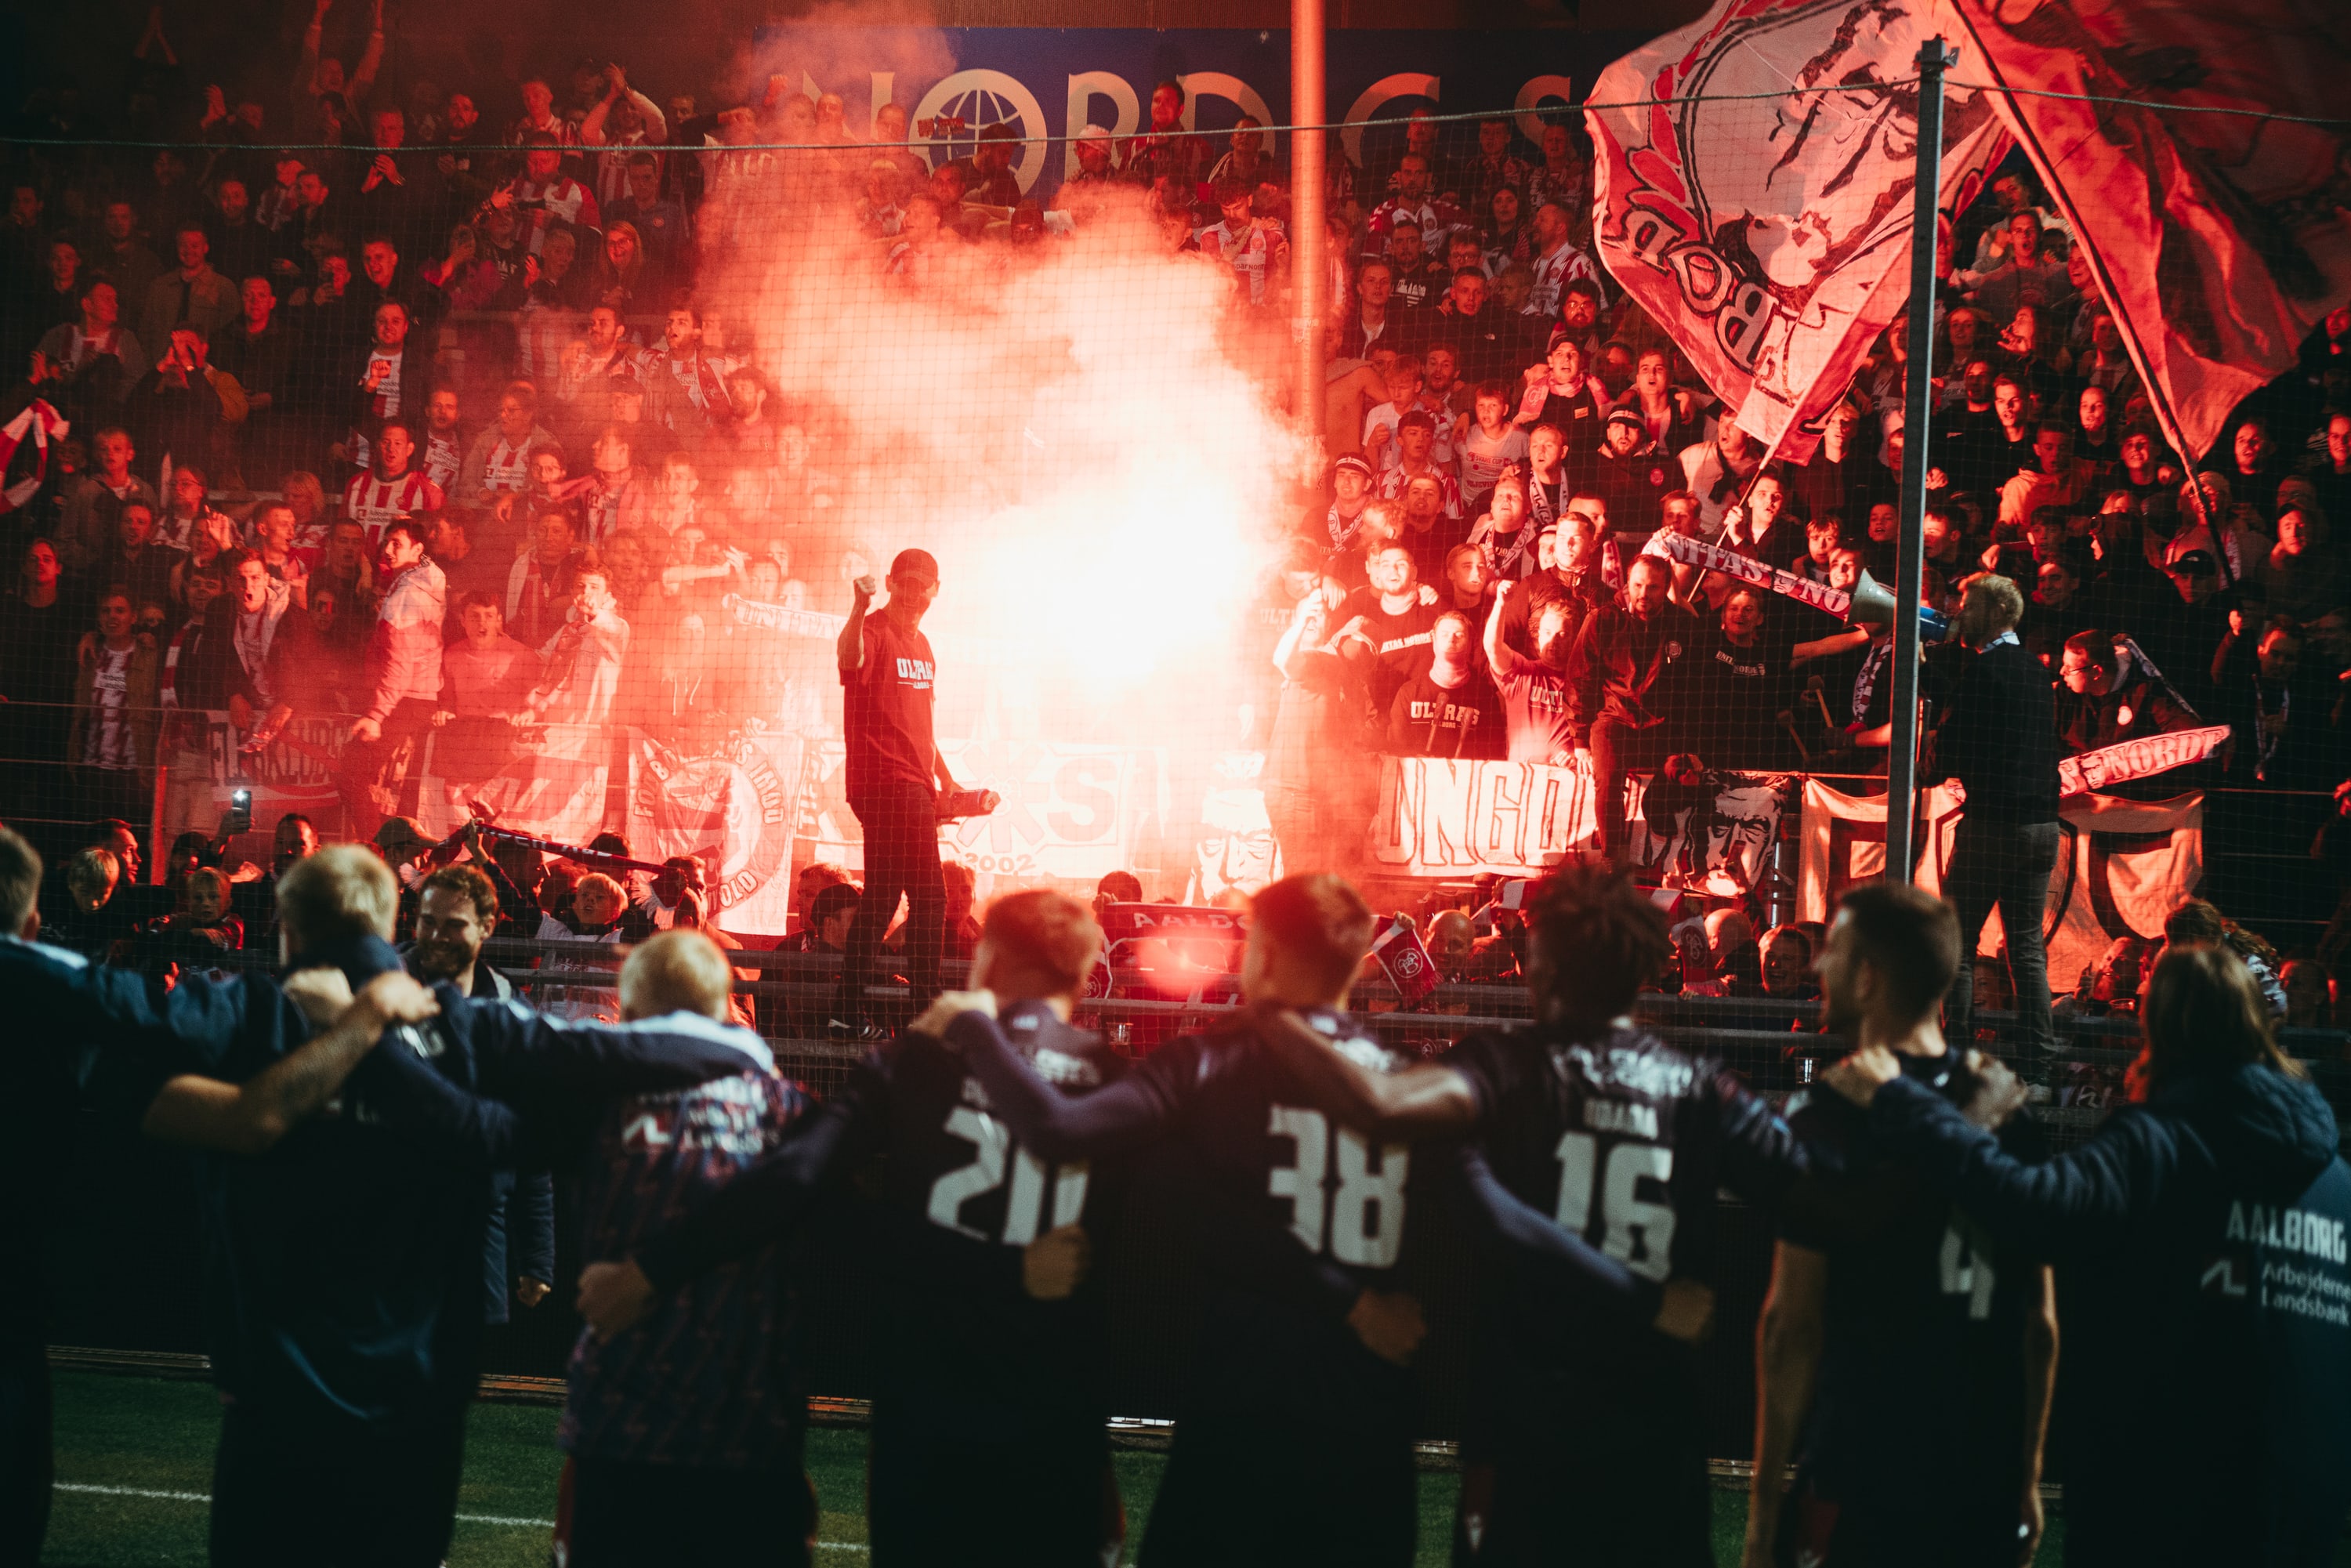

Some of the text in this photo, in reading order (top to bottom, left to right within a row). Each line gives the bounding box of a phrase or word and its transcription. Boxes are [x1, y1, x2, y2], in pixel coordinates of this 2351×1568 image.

[1665, 536, 1765, 583] NITAS
[748, 760, 784, 824] IMOD
[965, 852, 1037, 872] 2002
[2226, 1200, 2347, 1265] AALBORG
